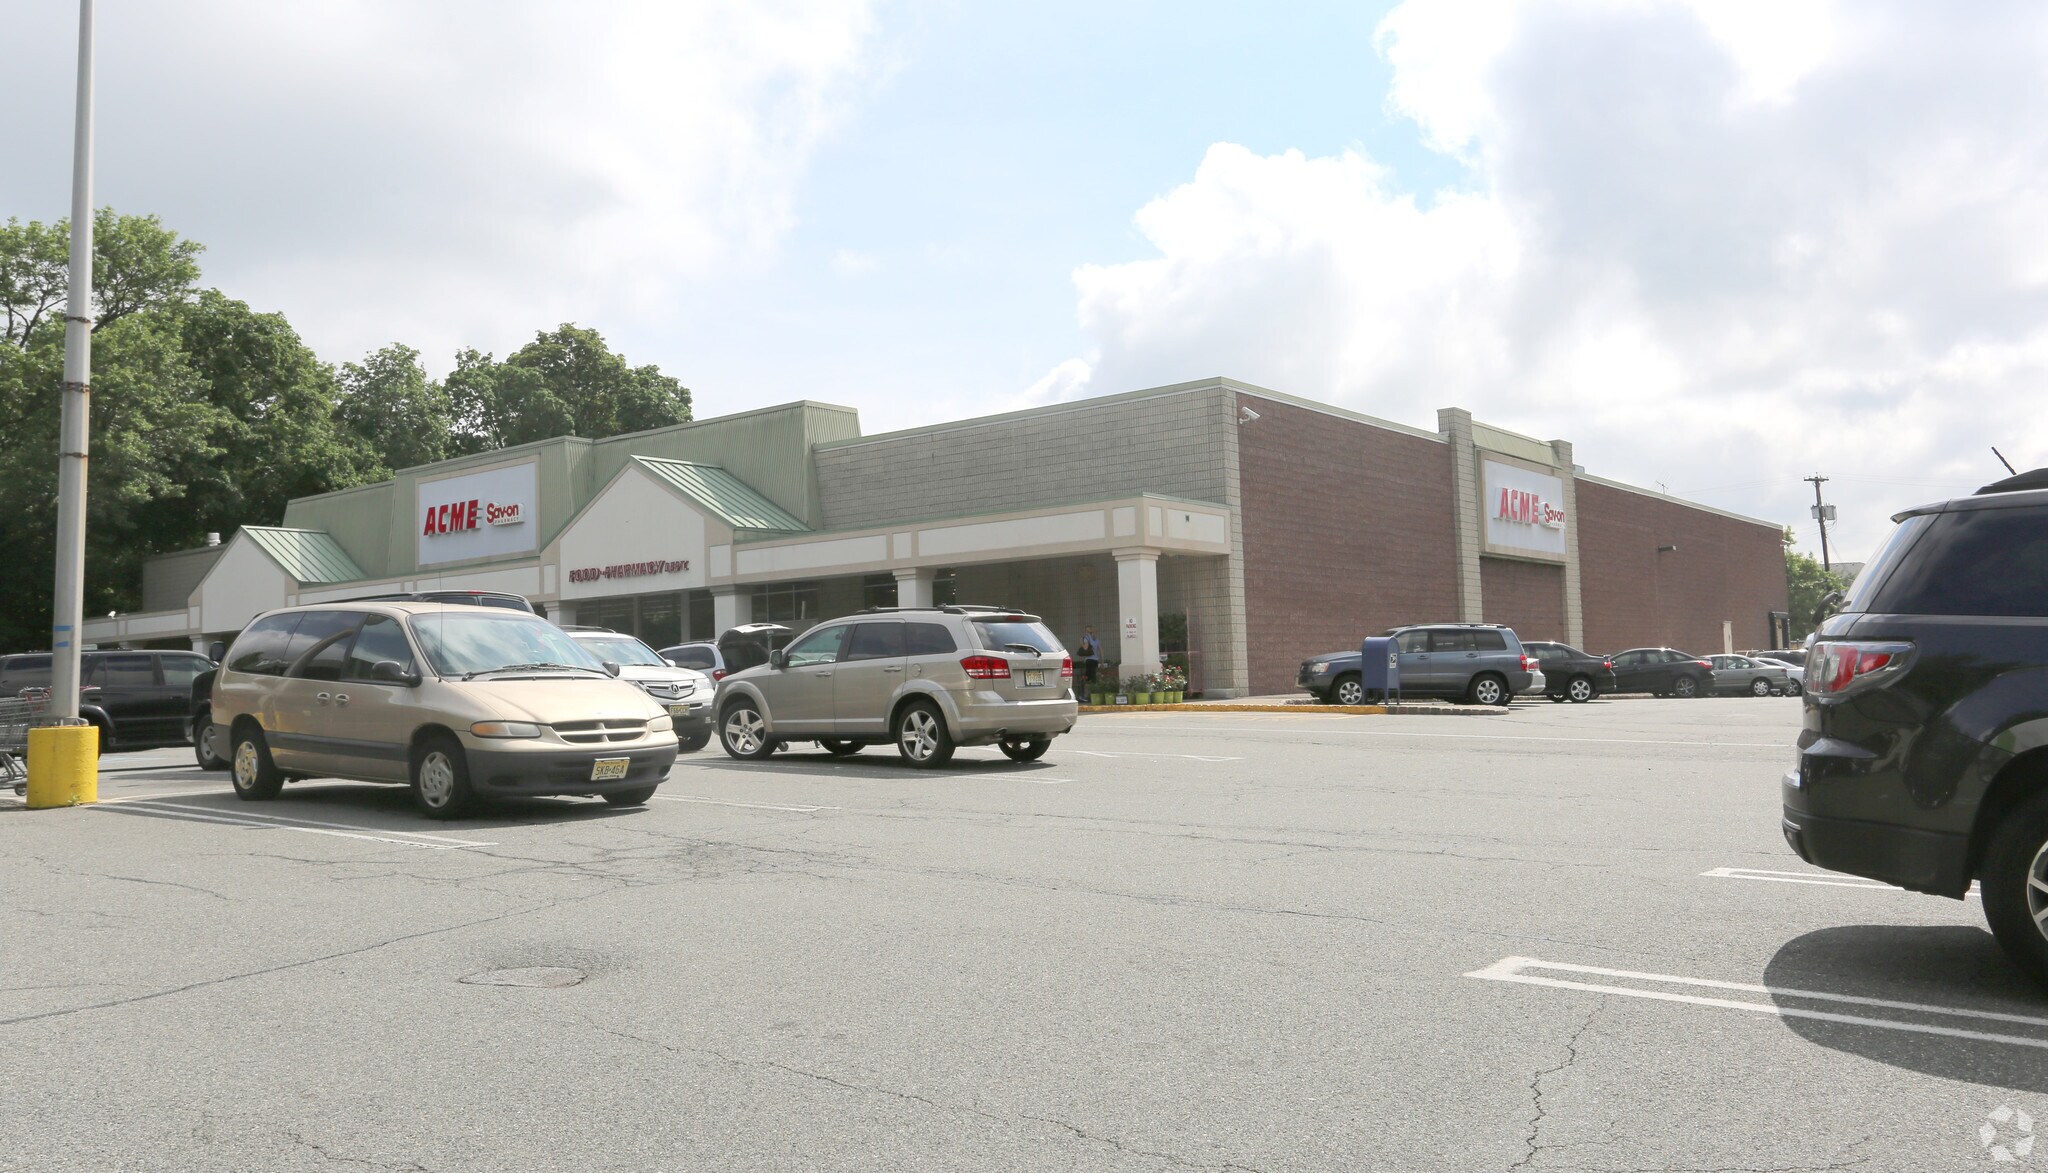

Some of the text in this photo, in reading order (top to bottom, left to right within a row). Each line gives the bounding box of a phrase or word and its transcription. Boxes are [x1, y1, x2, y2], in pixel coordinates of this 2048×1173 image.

[423, 499, 479, 536] ACME
[486, 502, 519, 524] Sav-on
[1499, 487, 1539, 525] ACME
